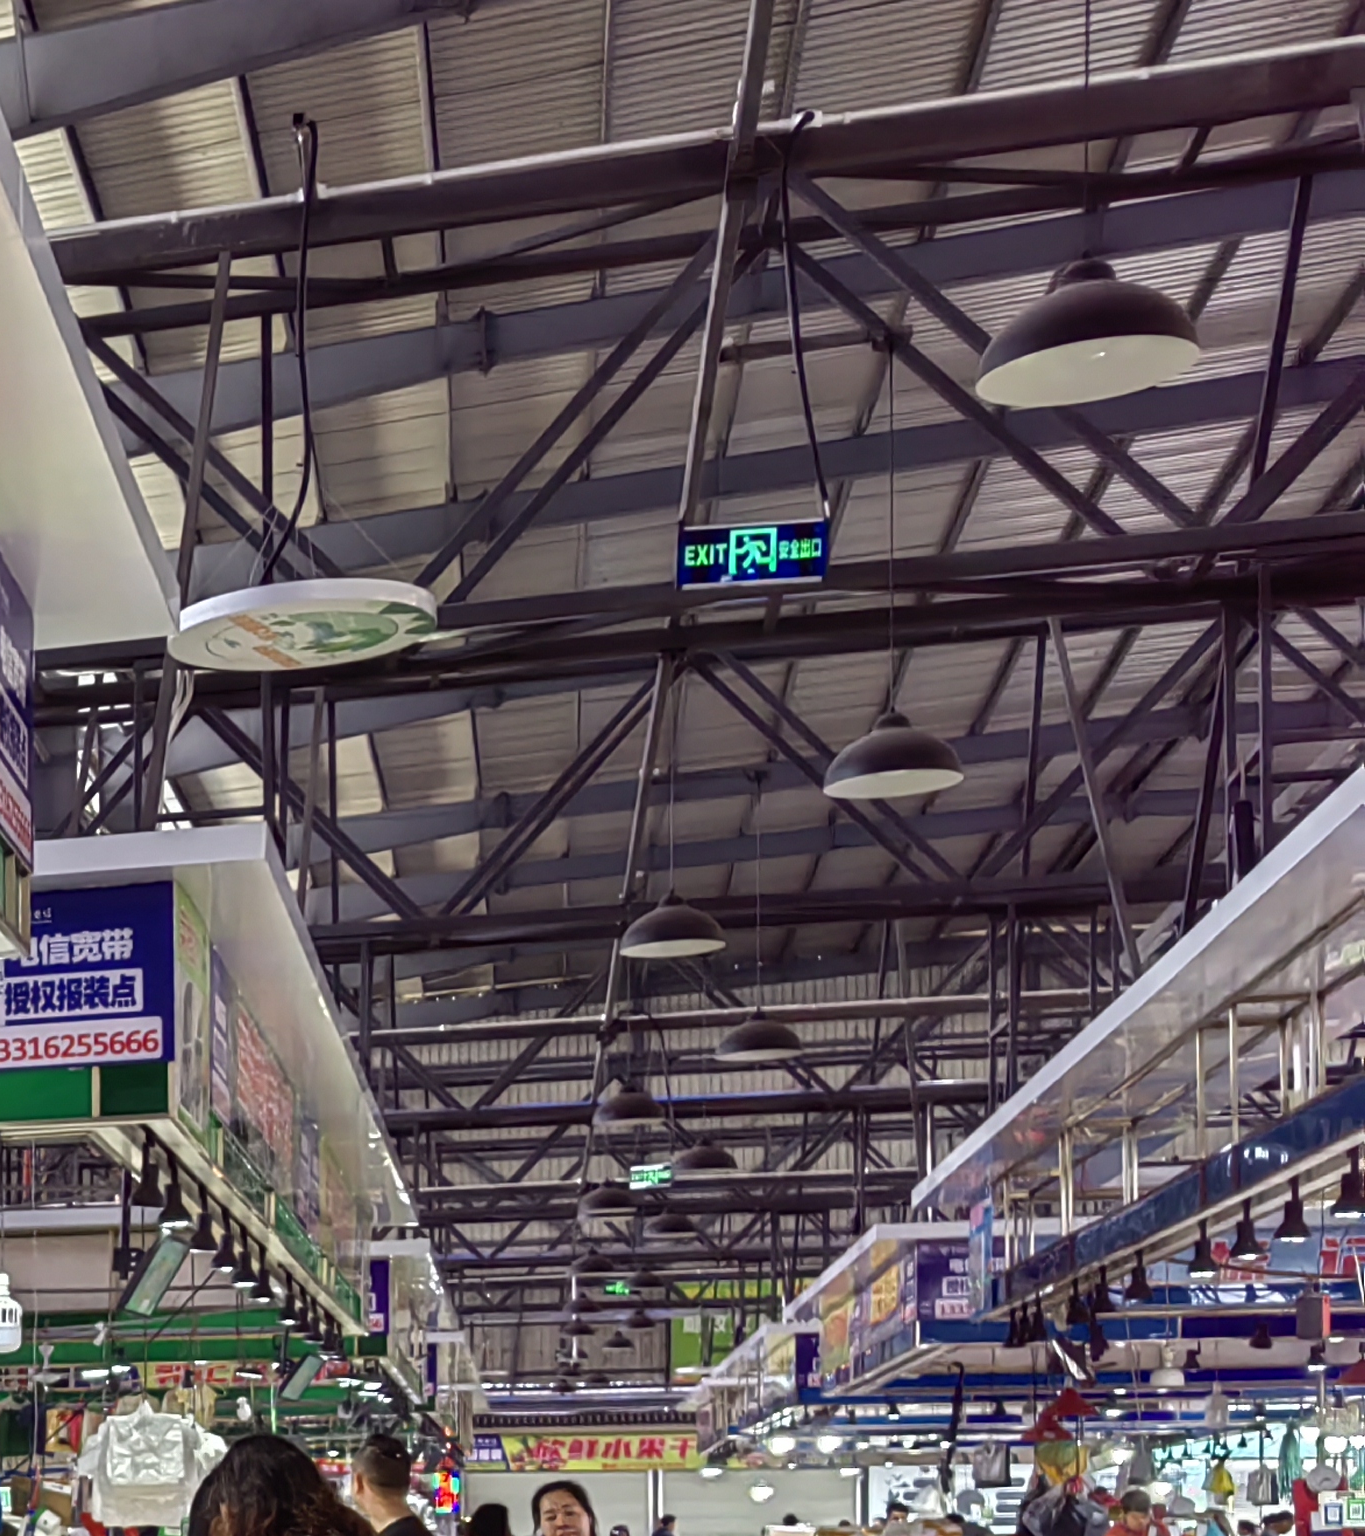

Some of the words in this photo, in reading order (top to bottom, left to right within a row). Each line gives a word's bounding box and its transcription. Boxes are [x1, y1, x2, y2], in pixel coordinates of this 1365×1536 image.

[684, 543, 728, 567] EXIT
[778, 538, 822, 560] 安全出口
[4, 972, 138, 1017] 授权报装点
